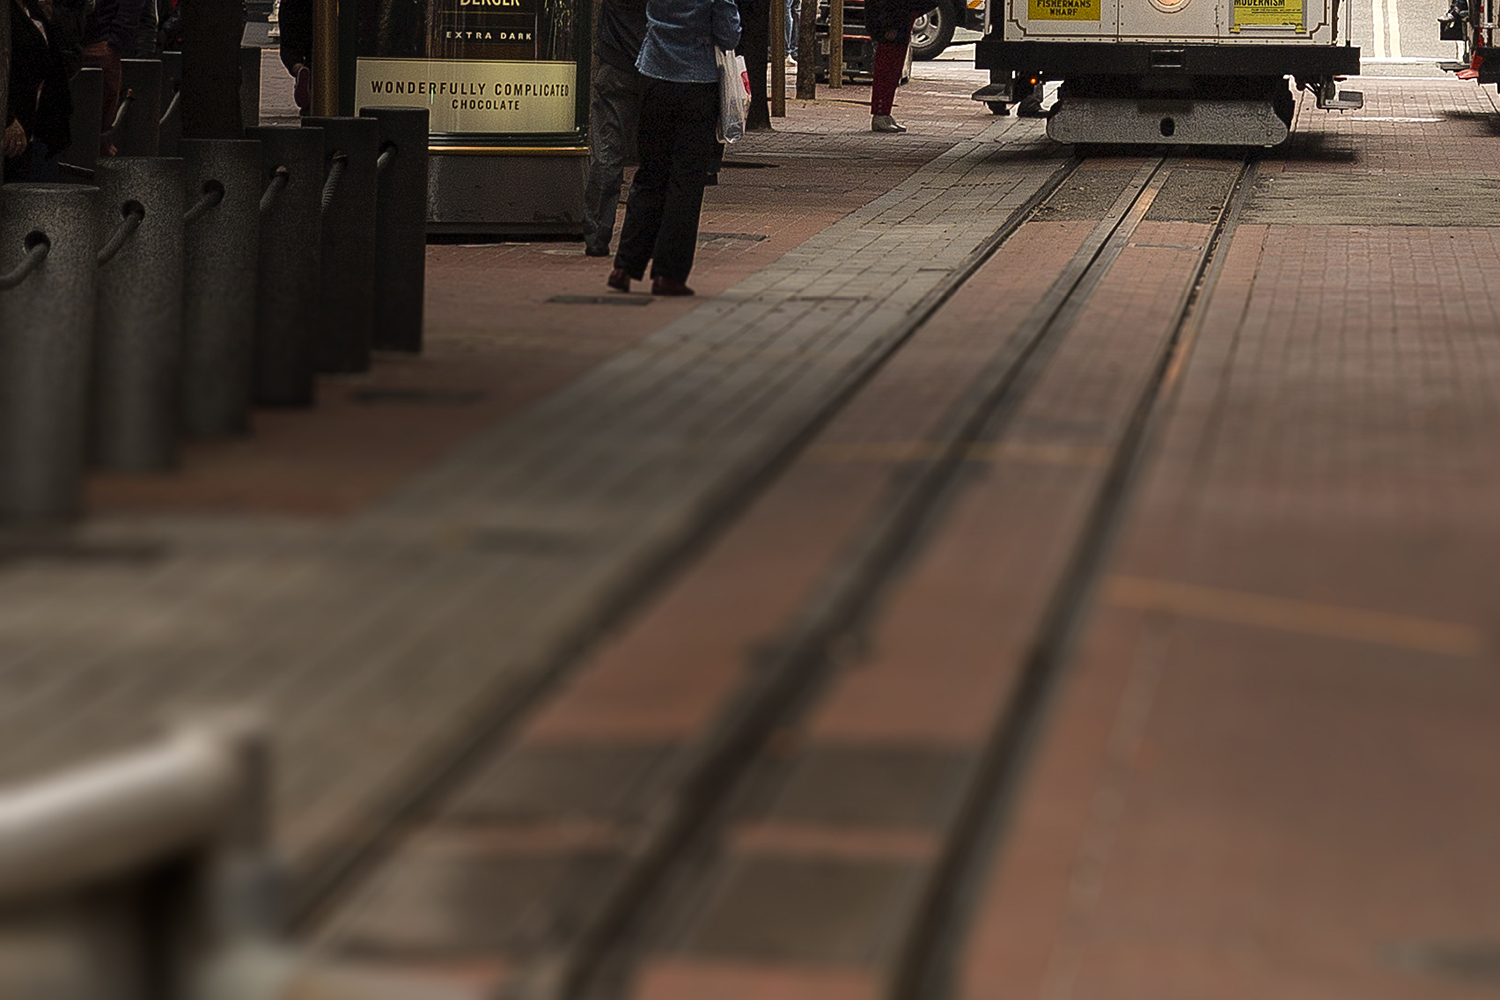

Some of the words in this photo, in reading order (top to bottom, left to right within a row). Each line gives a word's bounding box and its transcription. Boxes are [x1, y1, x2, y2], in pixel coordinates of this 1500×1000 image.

[1037, 0, 1092, 8] FISHERMANS
[1049, 8, 1079, 16] WHARF
[446, 31, 492, 40] EXTRA
[500, 32, 532, 40] DARK
[371, 80, 487, 95] WONDERFULLY
[495, 83, 569, 97] COMPLICATED
[452, 99, 520, 111] CHOCOLATE
